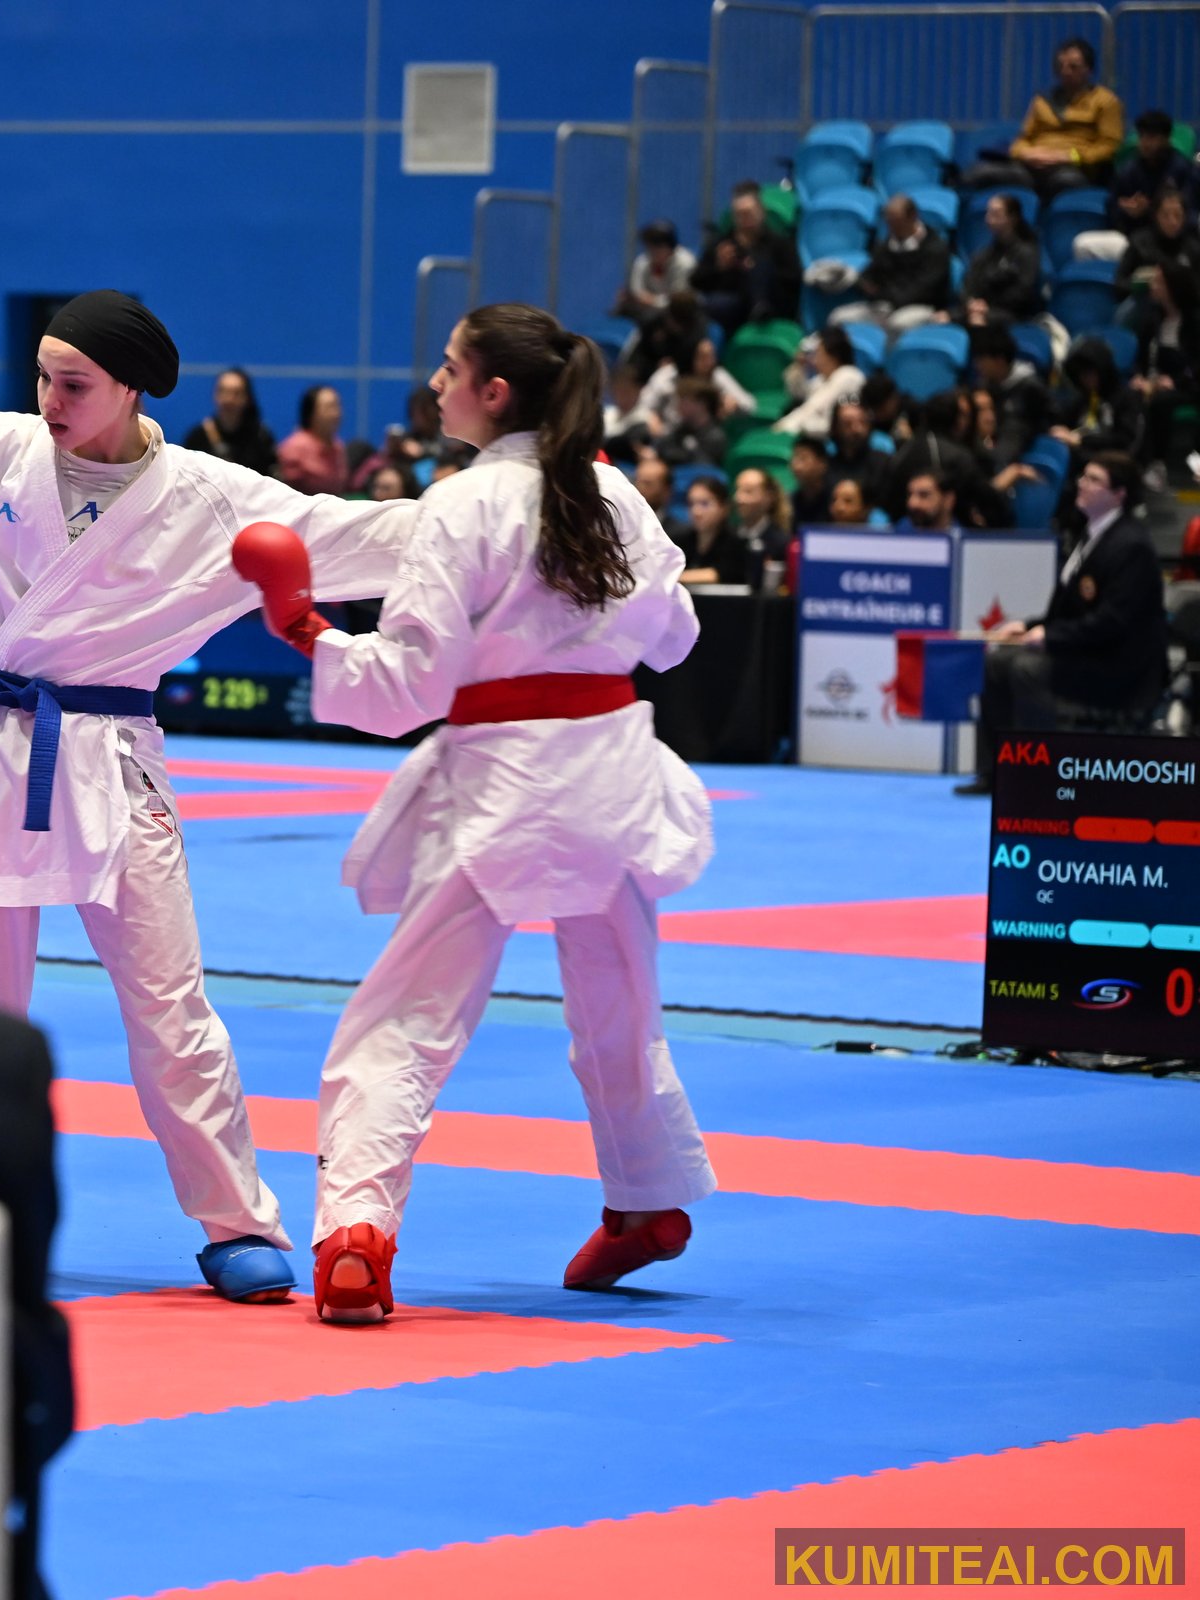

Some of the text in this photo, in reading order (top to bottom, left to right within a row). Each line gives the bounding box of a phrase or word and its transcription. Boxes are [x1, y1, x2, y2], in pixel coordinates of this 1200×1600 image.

[839, 570, 911, 595] COACH
[998, 741, 1050, 766] AKA
[1057, 756, 1196, 785] GHAMOOSHI
[1056, 786, 1075, 801] ON
[997, 817, 1070, 836] WARNING
[992, 843, 1031, 869] AO
[1037, 859, 1169, 888] OUYAHIA M.
[1036, 889, 1054, 904] QC
[992, 919, 1066, 939] WARNING
[989, 979, 1046, 1000] TATAMI
[1165, 967, 1194, 1017] 0
